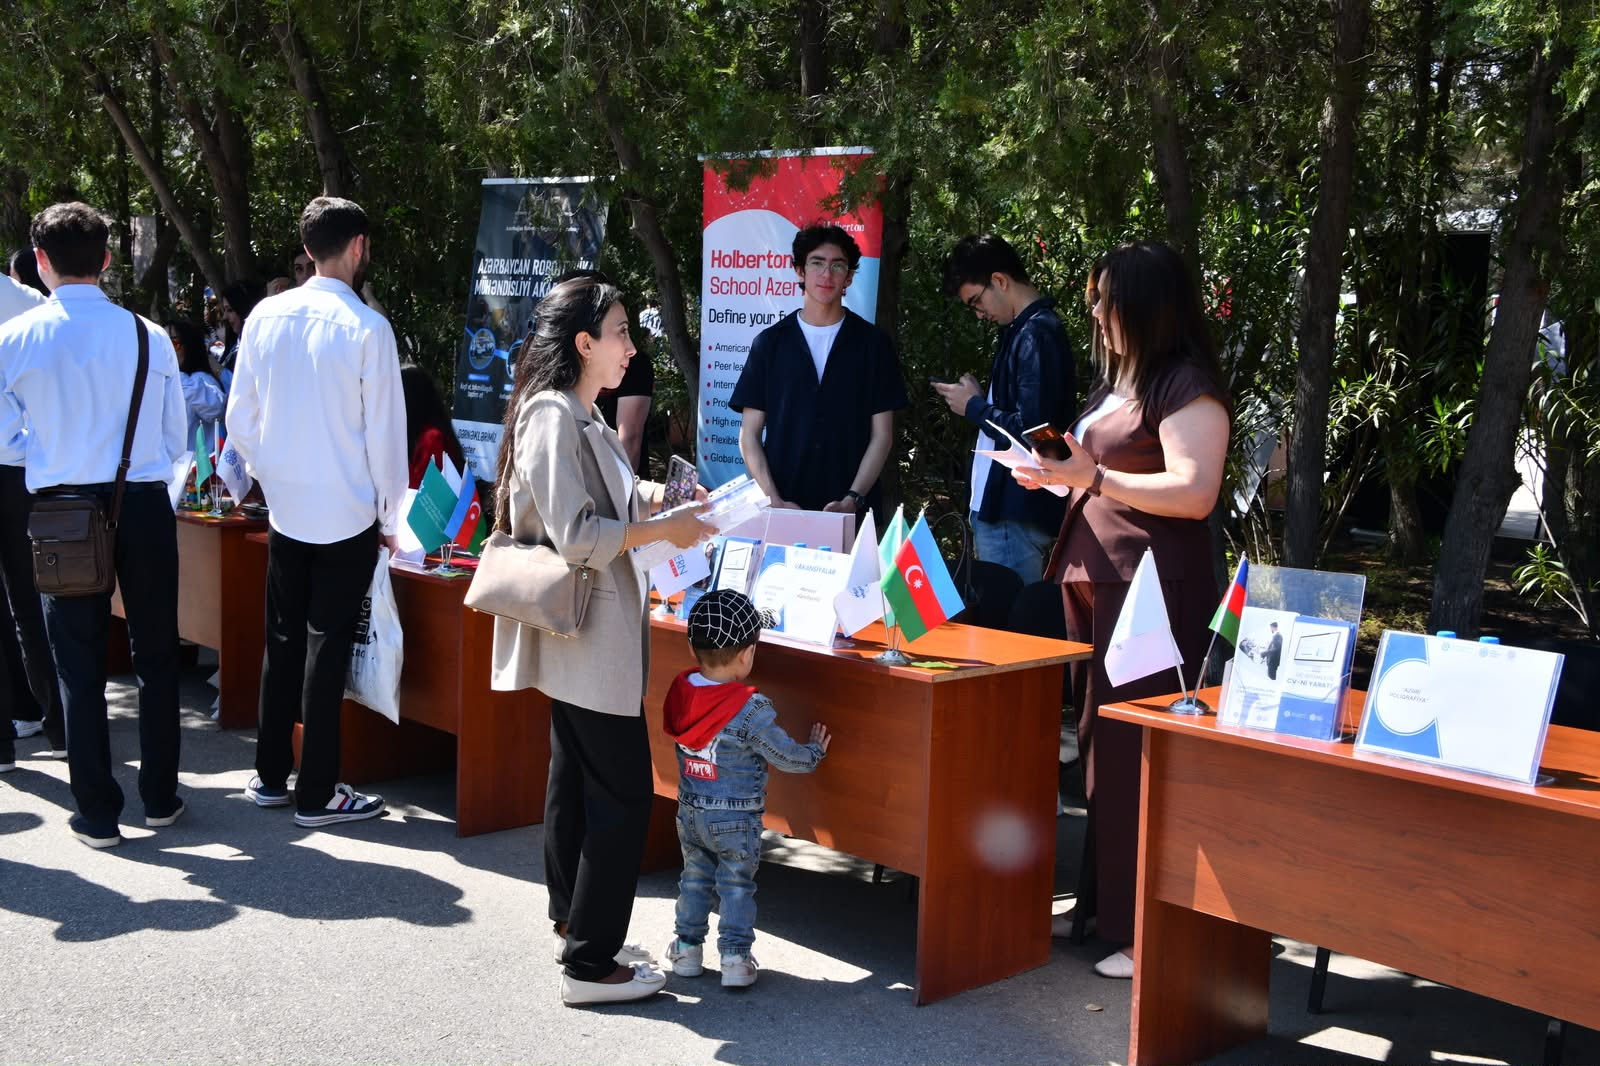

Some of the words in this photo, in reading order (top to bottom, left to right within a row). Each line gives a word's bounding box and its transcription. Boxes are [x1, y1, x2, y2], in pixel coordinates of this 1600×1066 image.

[711, 249, 793, 269] Holberton
[477, 257, 531, 275] AZƏRBAYCAN
[710, 276, 761, 296] School
[765, 277, 806, 297] Azer
[708, 308, 746, 325] Define
[750, 311, 776, 327] your
[714, 342, 751, 353] American
[714, 360, 732, 371] Peer
[711, 416, 729, 428] High
[711, 434, 739, 446] Flexible
[710, 452, 734, 464] Global
